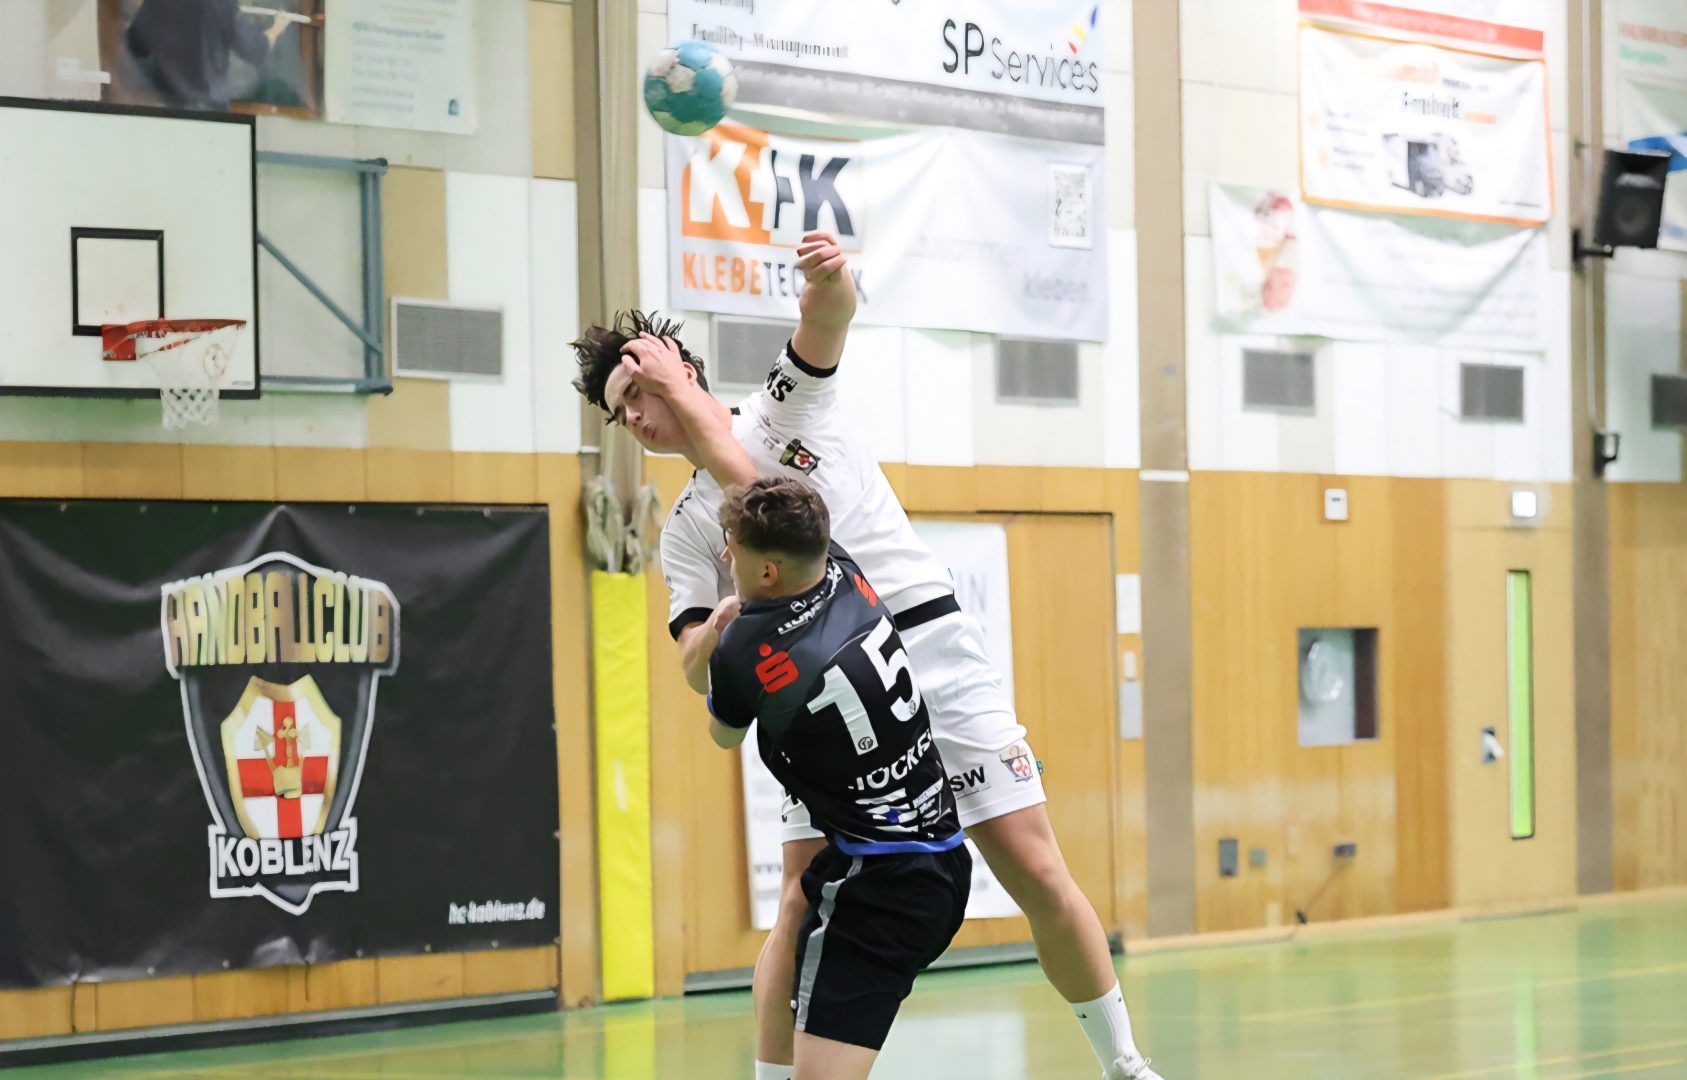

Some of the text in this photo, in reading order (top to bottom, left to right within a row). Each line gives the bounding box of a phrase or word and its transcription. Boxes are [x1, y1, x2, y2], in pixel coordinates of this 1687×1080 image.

[943, 18, 1099, 94] SP Services
[167, 571, 391, 666] HANDBALLCLUB
[806, 614, 922, 756] 15
[217, 830, 350, 878] KOBLENZ
